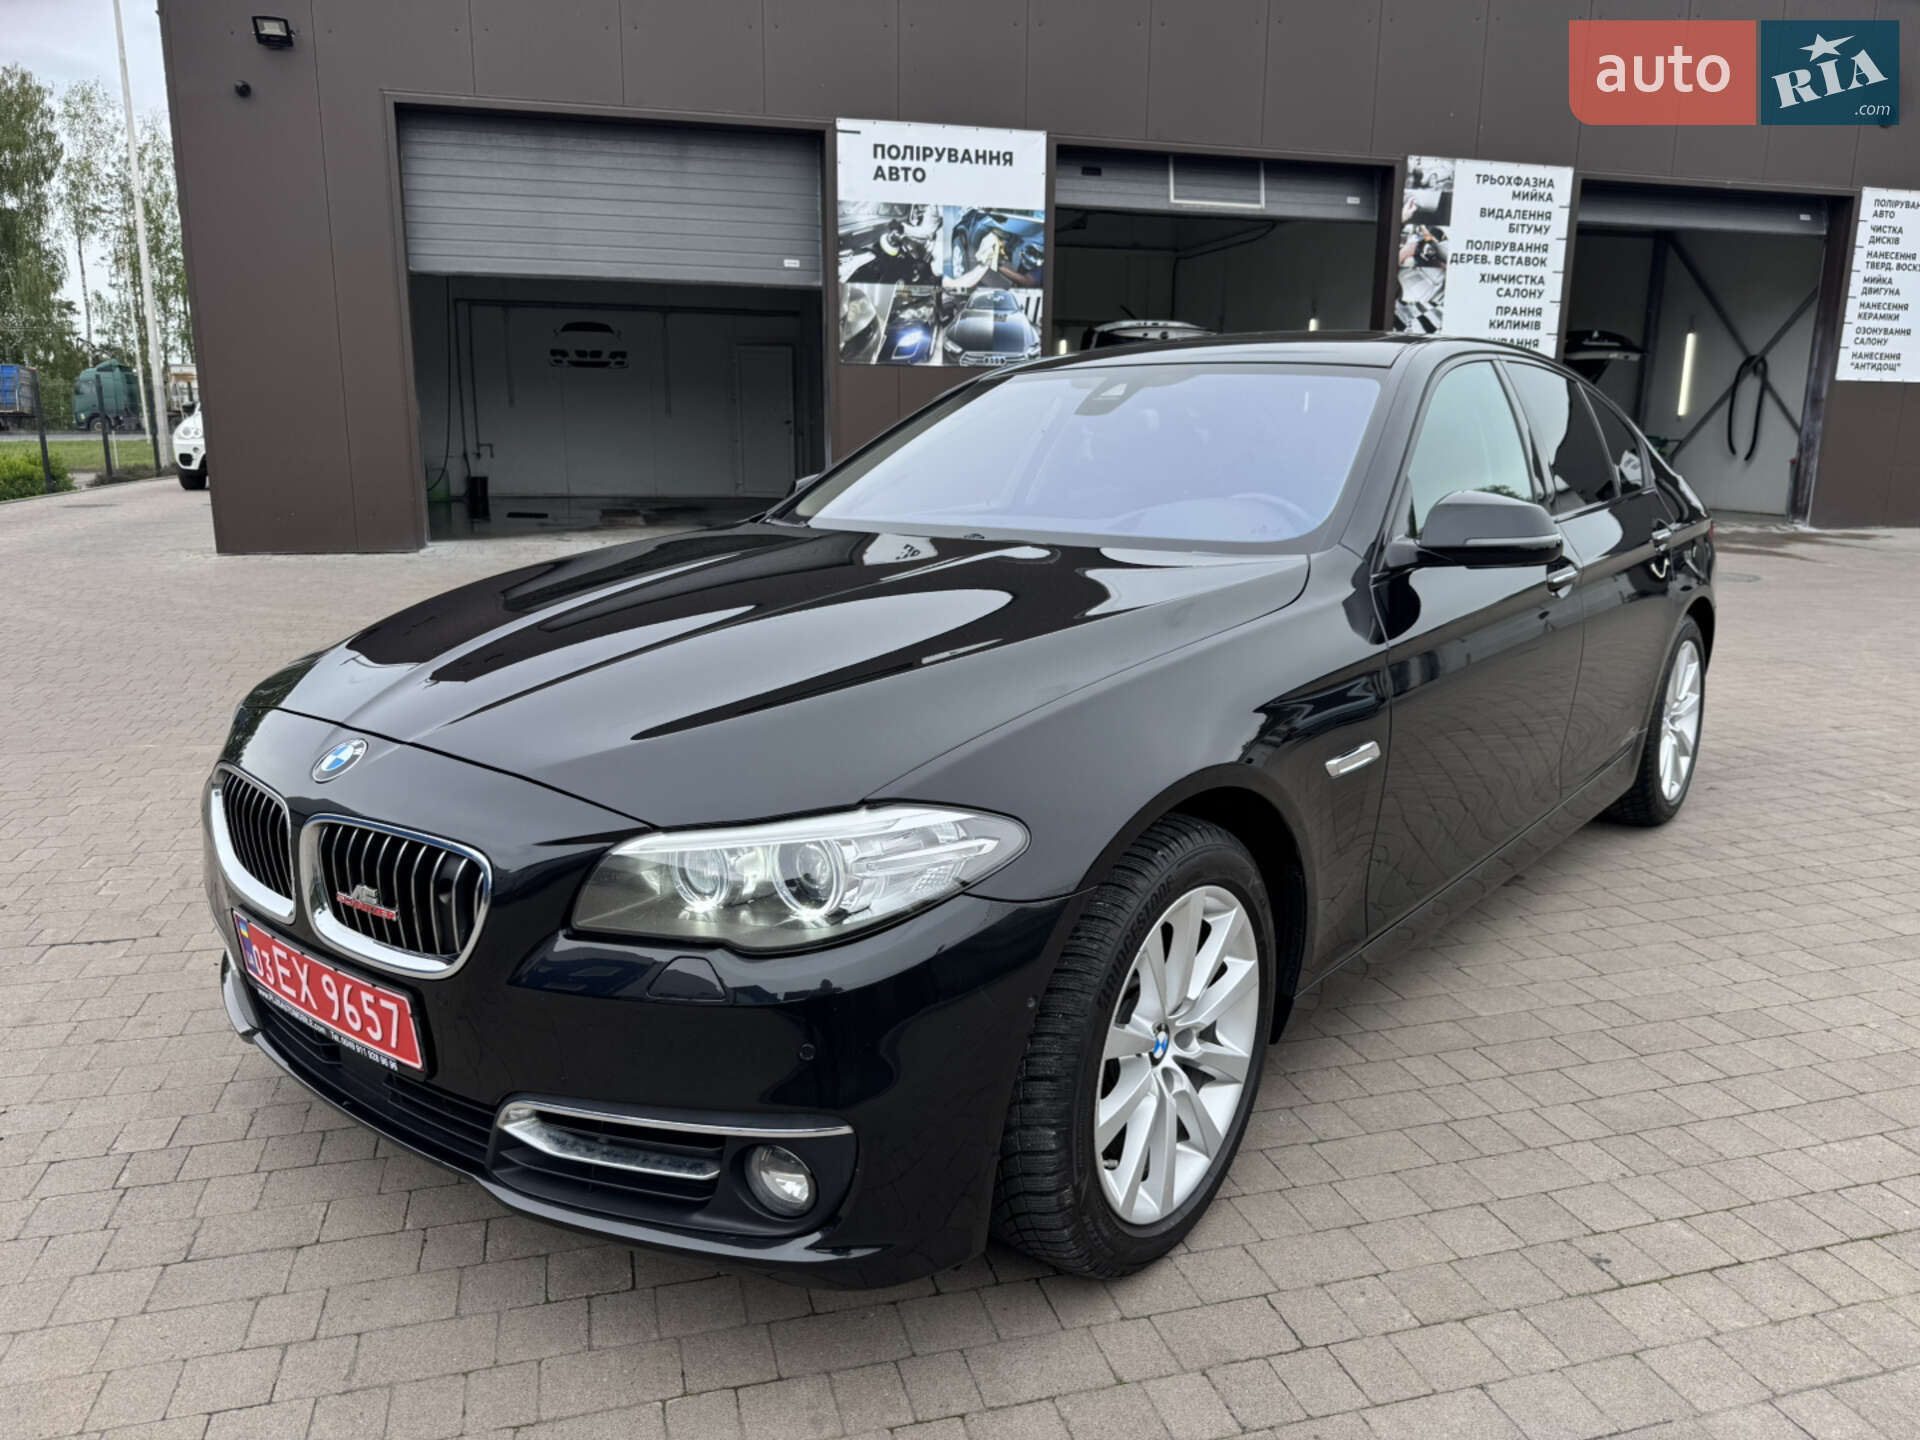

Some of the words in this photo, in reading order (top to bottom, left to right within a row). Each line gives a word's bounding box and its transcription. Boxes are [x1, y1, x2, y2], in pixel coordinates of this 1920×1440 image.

[872, 143, 1014, 167] ПОЛІРУВАННЯ
[872, 165, 926, 183] АВТО
[1475, 174, 1555, 188] ТРЬОХФАЗНА
[1512, 189, 1553, 202] МИЙКА
[1480, 207, 1552, 221] ВИДАЛЕННЯ
[1872, 210, 1895, 219] АВТО
[1508, 223, 1551, 235] БІТУМУ
[1870, 225, 1903, 234] ЧИСТКА
[1868, 235, 1900, 245] ДИСКІВ
[1466, 240, 1549, 253] ПОЛІРУВАННЯ
[1450, 253, 1491, 265] ДЕРЕВ.
[1494, 255, 1547, 267] ВСТАВОК
[1866, 250, 1917, 261] НАНЕСЕННЯ
[1479, 273, 1545, 285] ХІМЧИСТКА
[1862, 274, 1893, 285] МИЙКА
[1496, 287, 1544, 299] САЛОНУ
[1861, 286, 1901, 296] ДВИГУНА
[1495, 306, 1542, 317] ПРАННЯ
[1859, 302, 1909, 311] НАНЕСЕННЯ
[1857, 312, 1900, 321] КЕРАМІКИ
[1489, 320, 1541, 330] КИЛИМІВ
[1855, 327, 1912, 336] ОЗОНУВАННЯ
[1854, 337, 1888, 346] САЛОНУ
[1851, 352, 1901, 360] НАНЕСЕННЯ
[1850, 362, 1901, 372] "АНТИДОЩ"
